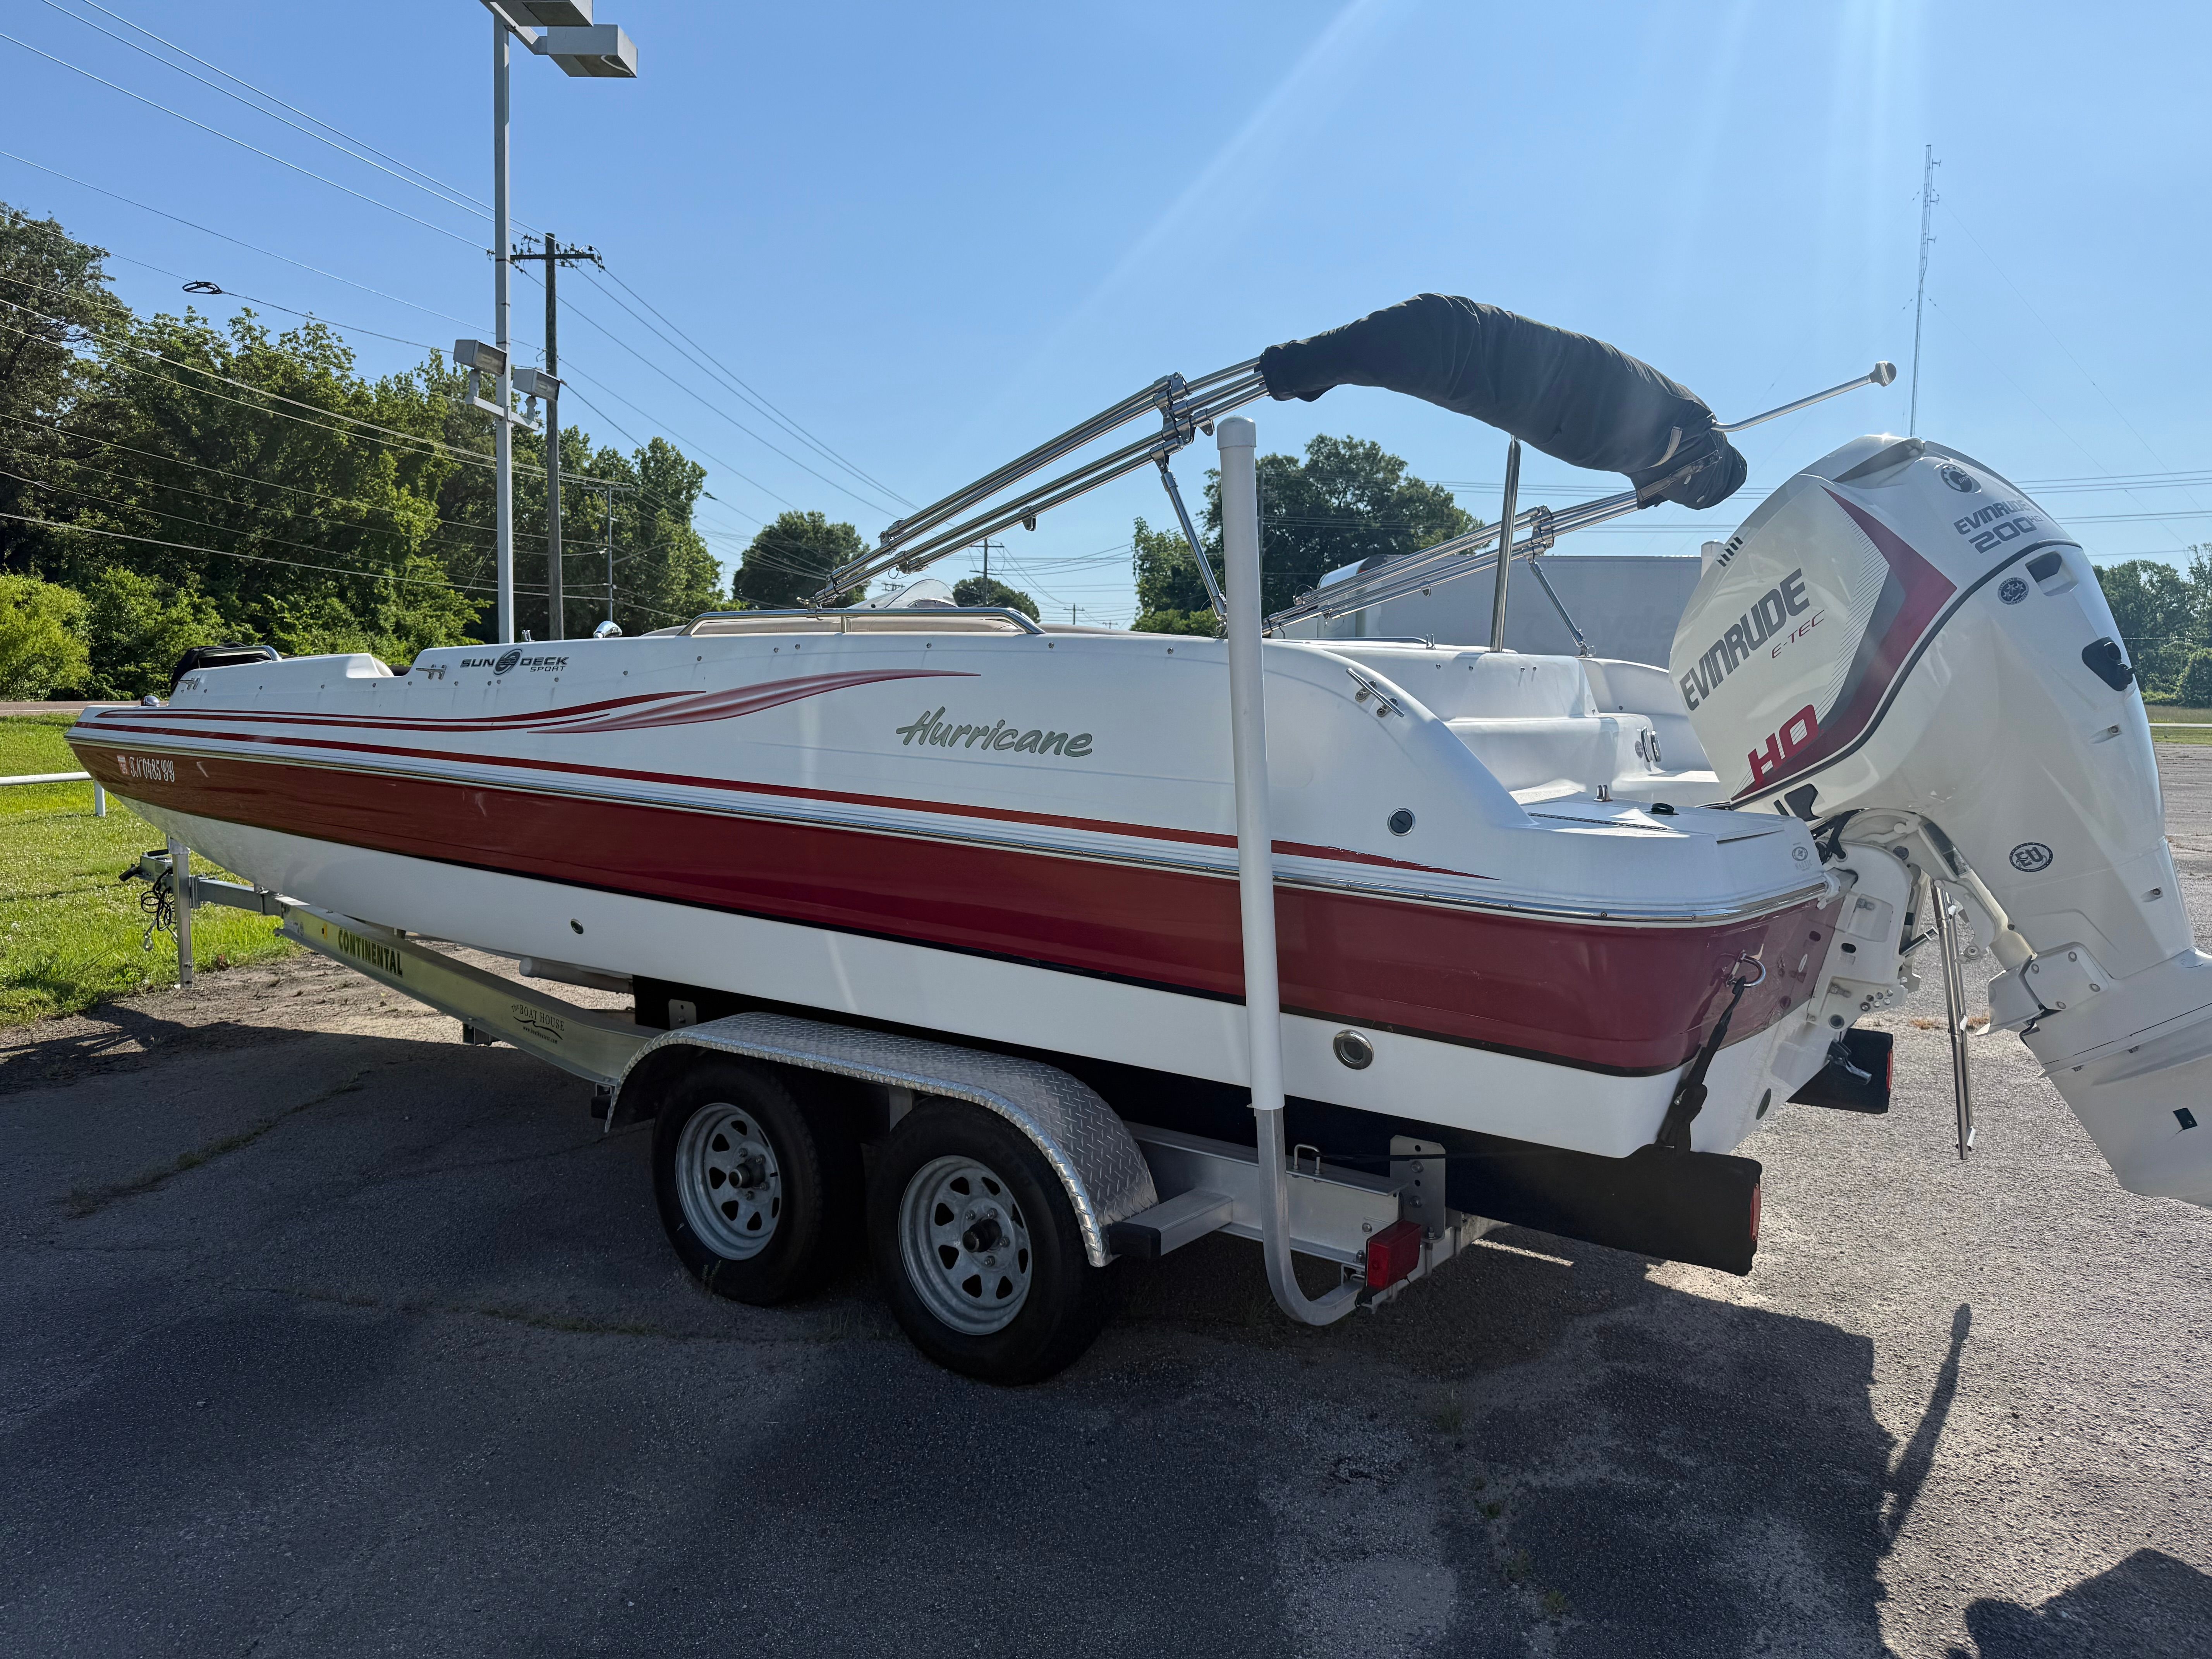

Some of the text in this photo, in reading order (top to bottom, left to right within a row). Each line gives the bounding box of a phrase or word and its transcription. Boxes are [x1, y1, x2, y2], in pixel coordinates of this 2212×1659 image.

[1958, 476, 1969, 484] BRP
[1953, 500, 2031, 535] EVINRUDE
[1968, 517, 2037, 554] 200
[1679, 567, 1810, 711] EVINRUDE
[1771, 609, 1825, 659] E-TEC
[460, 658, 496, 668] SUN
[519, 657, 569, 666] DECK
[896, 706, 1092, 757] Hurricane
[1747, 704, 1819, 785] HO
[338, 927, 403, 978] CONTINENTAL
[520, 1004, 537, 1020] BOAT
[540, 1012, 564, 1031] HOUSE
